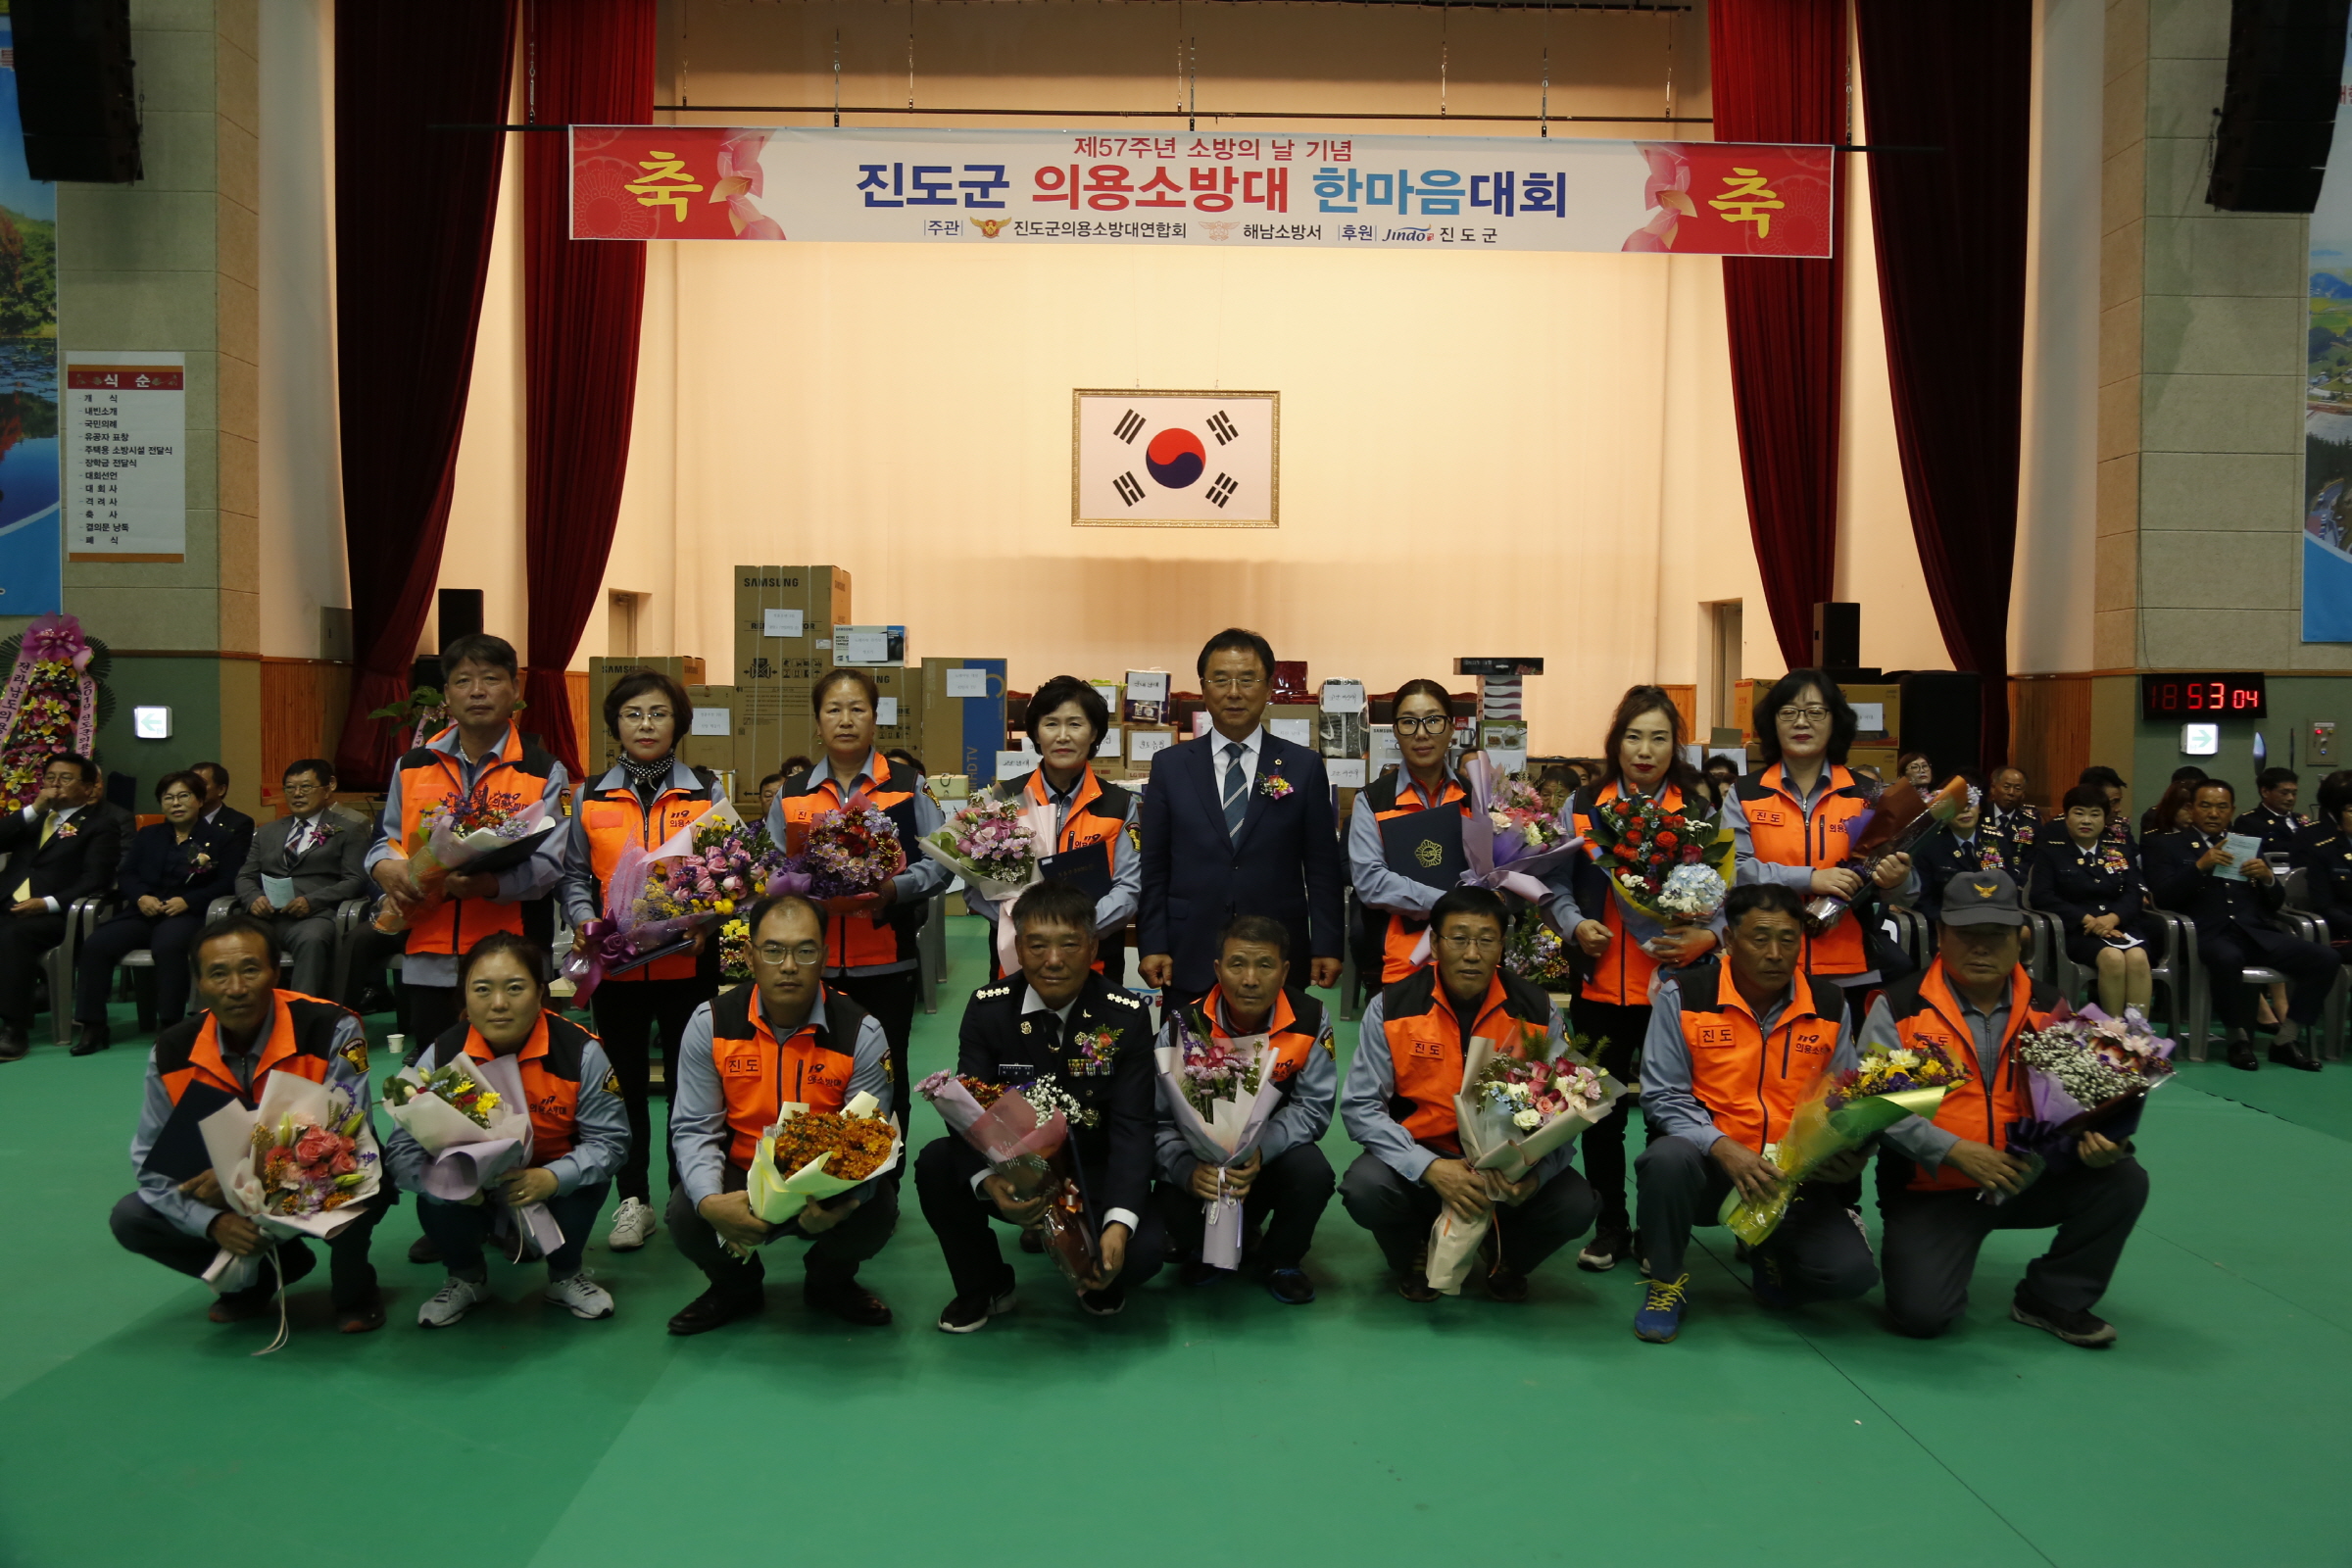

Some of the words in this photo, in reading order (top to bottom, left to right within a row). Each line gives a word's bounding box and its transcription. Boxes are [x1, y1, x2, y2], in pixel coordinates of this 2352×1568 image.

[1074, 136, 1177, 159] 제57주년
[1187, 138, 1260, 162] 소방의
[1271, 139, 1295, 162] 날
[1305, 139, 1351, 163] 기념
[624, 150, 704, 222] 축
[856, 163, 1010, 209] 진도군
[1032, 164, 1288, 214] 의용소방대
[1707, 167, 1786, 239] 축
[927, 220, 960, 236] 주관
[1013, 220, 1187, 239] 진도군의용소방대연합회
[1243, 223, 1322, 241] 해남소방서
[1342, 224, 1373, 242] 후원
[84, 407, 118, 416] 내빈소개
[84, 419, 118, 429] 국민의례
[84, 433, 110, 442] 유공자
[113, 433, 129, 442] 표창
[84, 445, 110, 455] 주택용
[112, 446, 145, 456] 소방시설
[148, 446, 172, 456] 전달식
[84, 459, 110, 467] 장학금
[113, 459, 137, 467] 전달식
[85, 471, 118, 480] 대회선언
[744, 577, 799, 587] SAMSUNG
[2186, 682, 2225, 710] 53
[2232, 689, 2259, 710] 04
